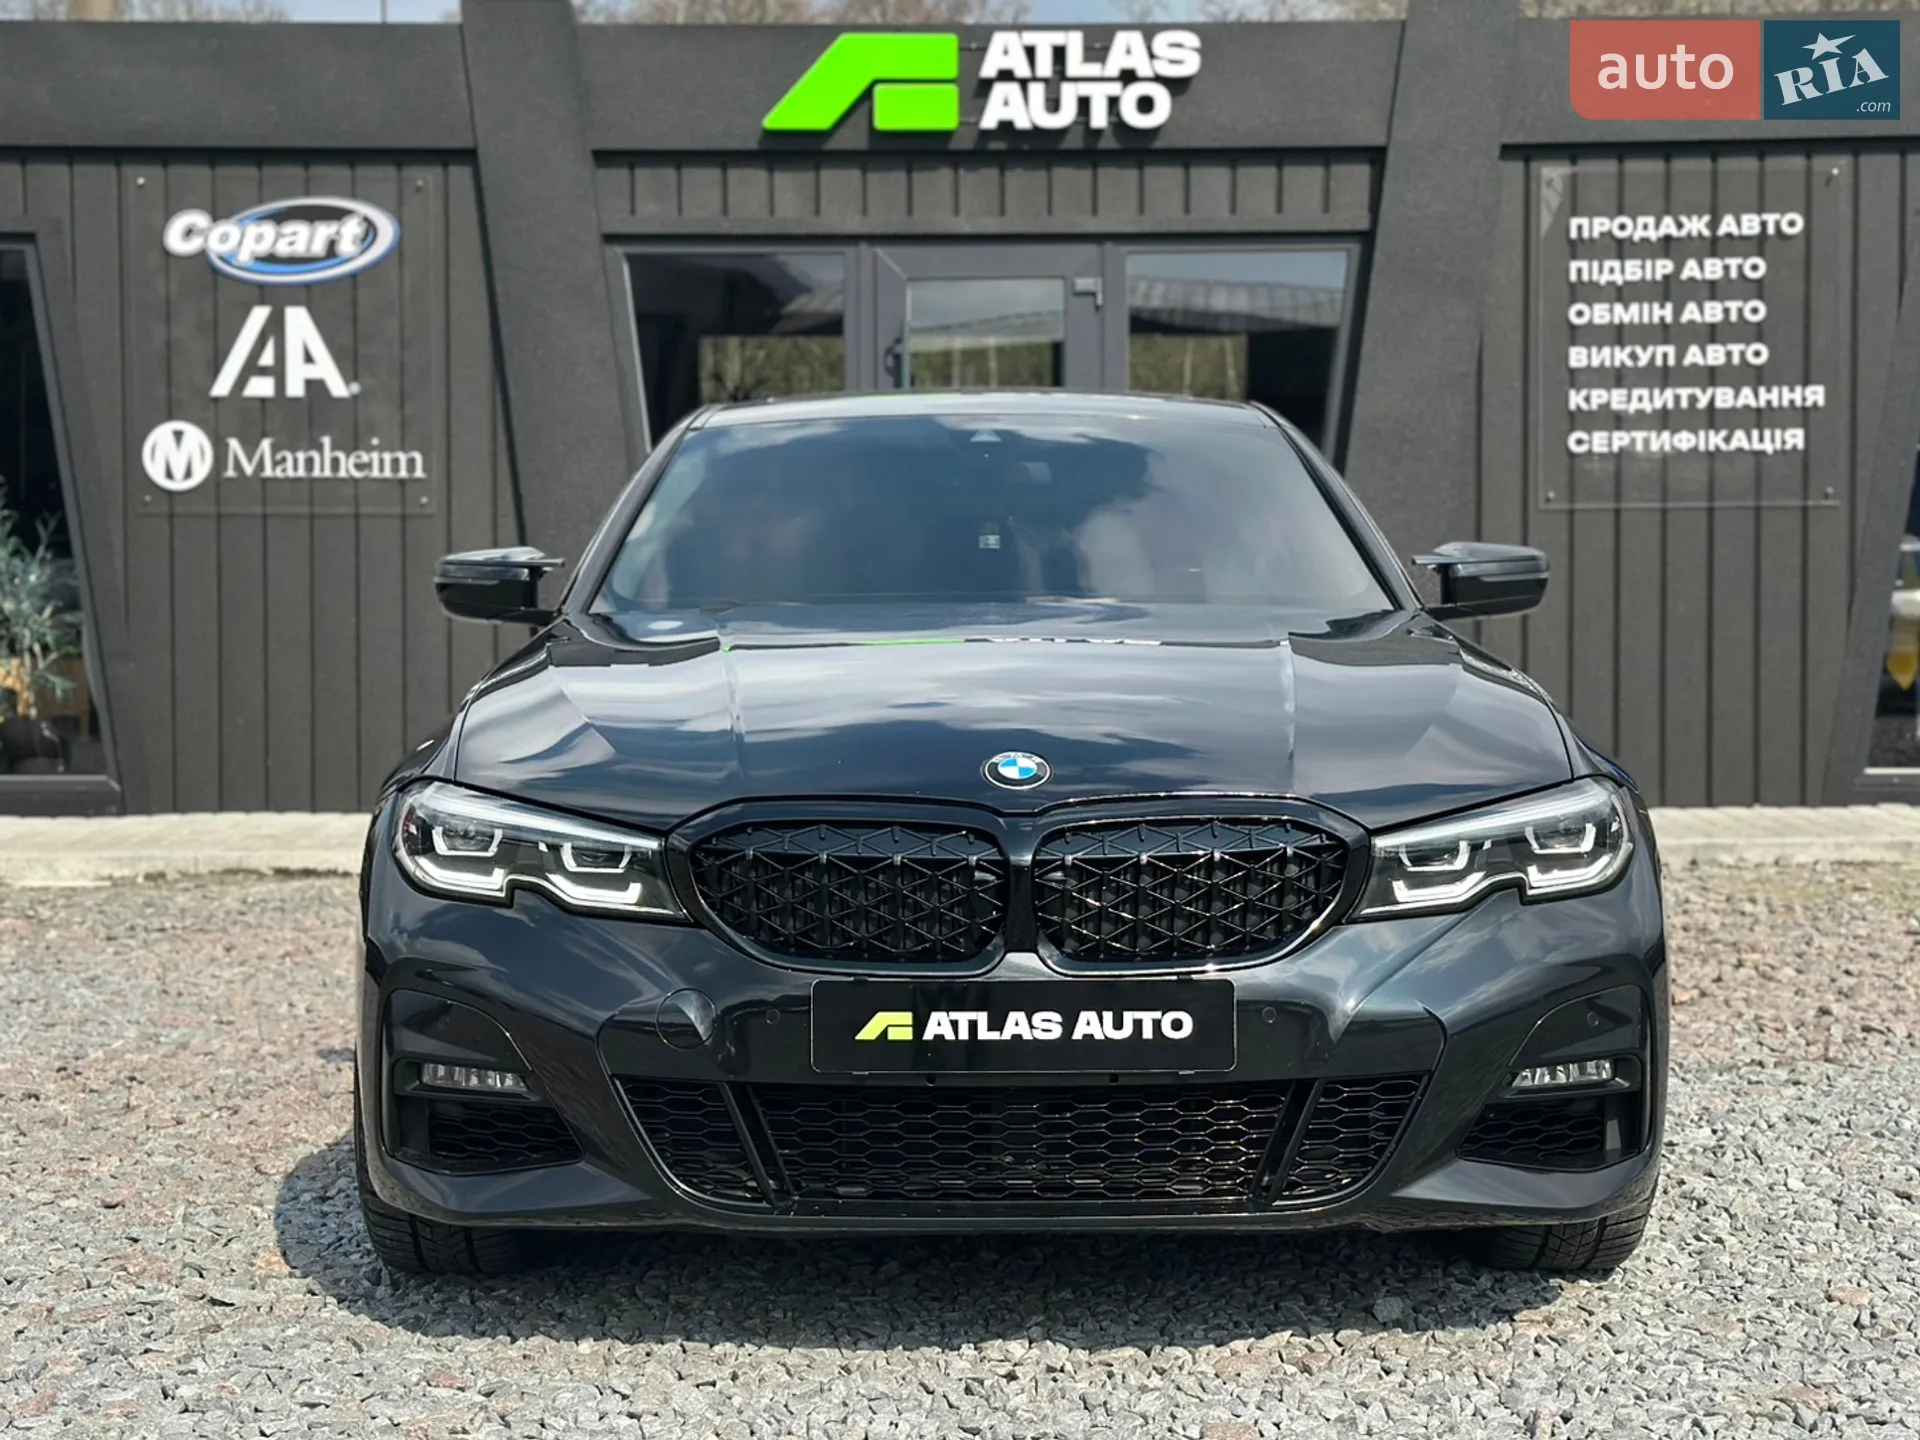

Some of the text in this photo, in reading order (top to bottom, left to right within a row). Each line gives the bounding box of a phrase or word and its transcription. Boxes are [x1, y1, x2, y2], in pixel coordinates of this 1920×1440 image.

[979, 30, 1201, 78] ATLAS
[979, 81, 1172, 130] AUTO
[162, 207, 366, 266] Copart
[1569, 212, 1804, 242] ПРОДАЖ АВТО
[1569, 256, 1767, 286] ПІДБІР АВТО
[1568, 299, 1767, 325] ОБМІН АВТО
[1568, 342, 1769, 368] ВИКУП АВТО
[1568, 384, 1826, 414] КРЕДИТУВАННЯ
[222, 435, 426, 478] Manheim
[1567, 428, 1805, 455] СЕРТИФІКАЦІЯ
[922, 1010, 1194, 1041] ATLAS AUTO
